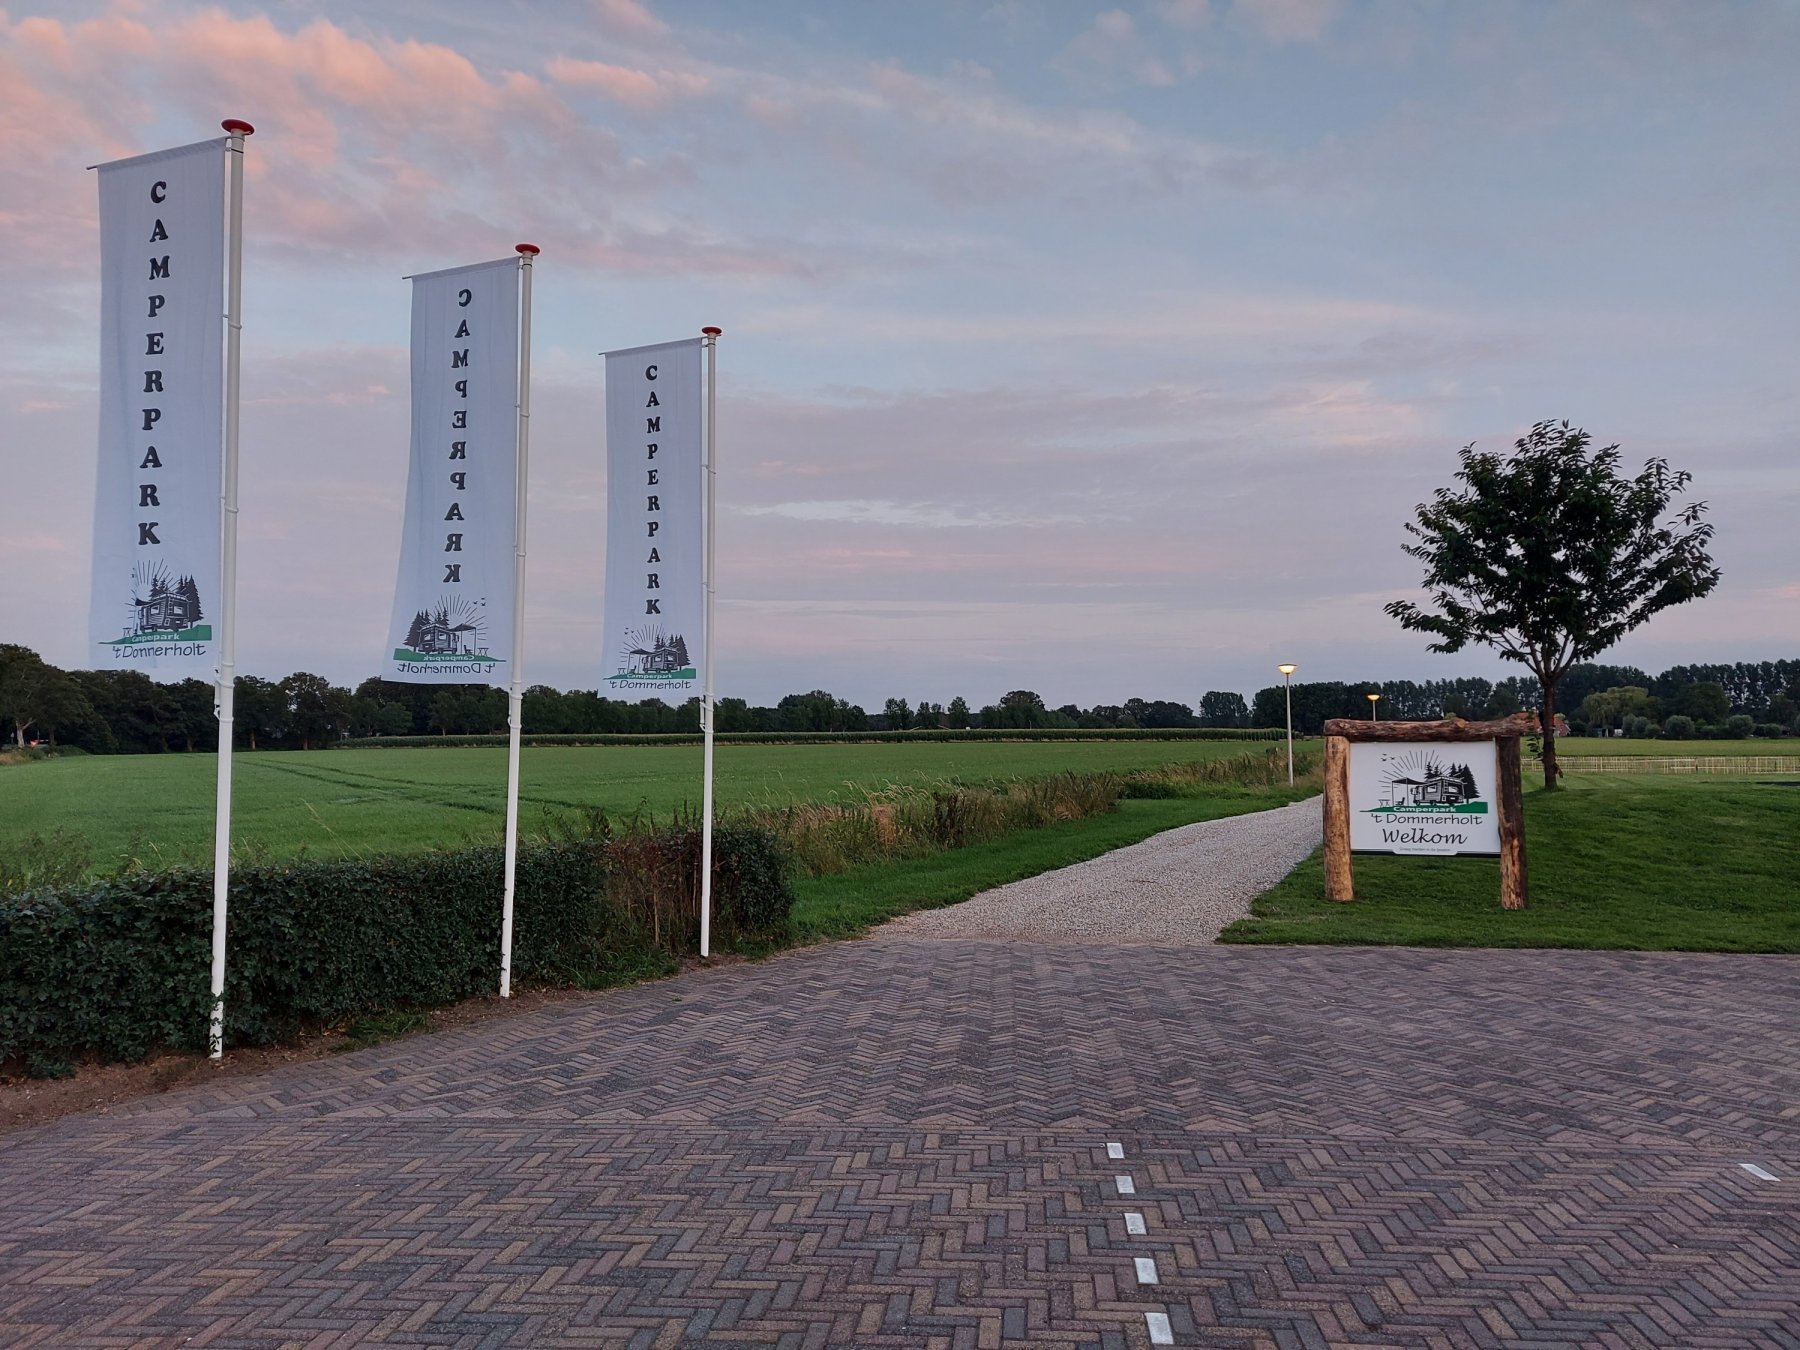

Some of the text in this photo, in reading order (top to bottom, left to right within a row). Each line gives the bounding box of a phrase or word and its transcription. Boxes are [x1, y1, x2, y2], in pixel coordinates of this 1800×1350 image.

[138, 181, 171, 546] CAMPERPARK
[645, 365, 661, 615] CAMPERPARK
[619, 680, 692, 690] Dommerholt
[1393, 806, 1457, 814] Camperpark
[1386, 813, 1483, 825] Dommerholt
[1382, 828, 1468, 845] Welkom
